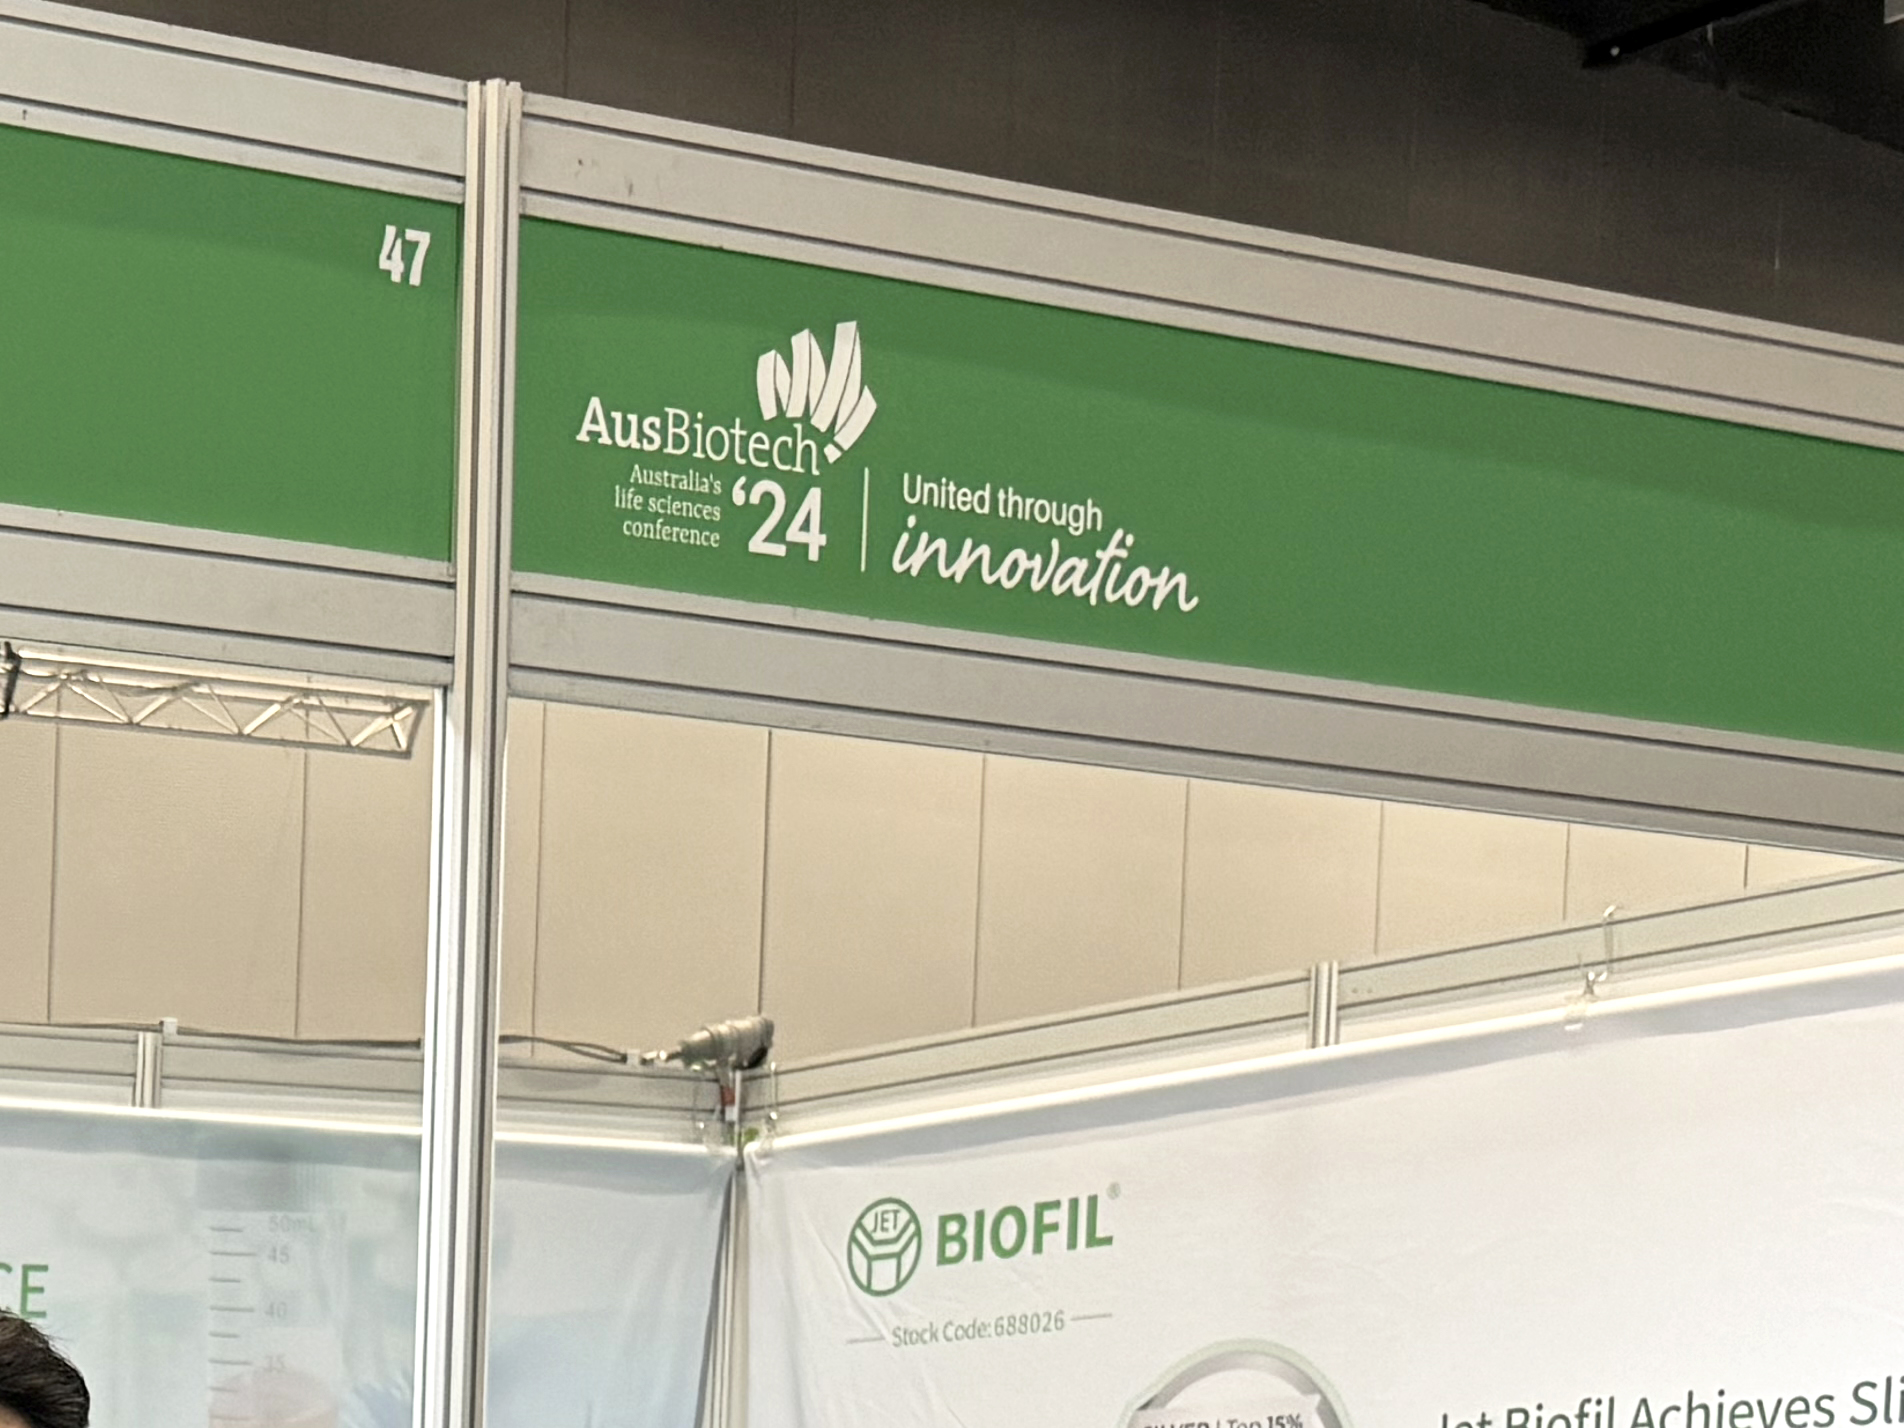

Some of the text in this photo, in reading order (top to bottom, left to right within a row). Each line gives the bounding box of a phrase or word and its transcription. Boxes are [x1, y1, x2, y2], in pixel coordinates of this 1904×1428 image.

[378, 224, 431, 286] 47
[576, 396, 820, 476] AusBiotech
[629, 463, 723, 497] Australia's
[614, 484, 721, 522] life sciences
[902, 472, 1103, 534] United through
[622, 514, 721, 549] conference
[890, 527, 1199, 614] innovation
[871, 1209, 900, 1234] JET
[892, 1321, 939, 1348] Stock
